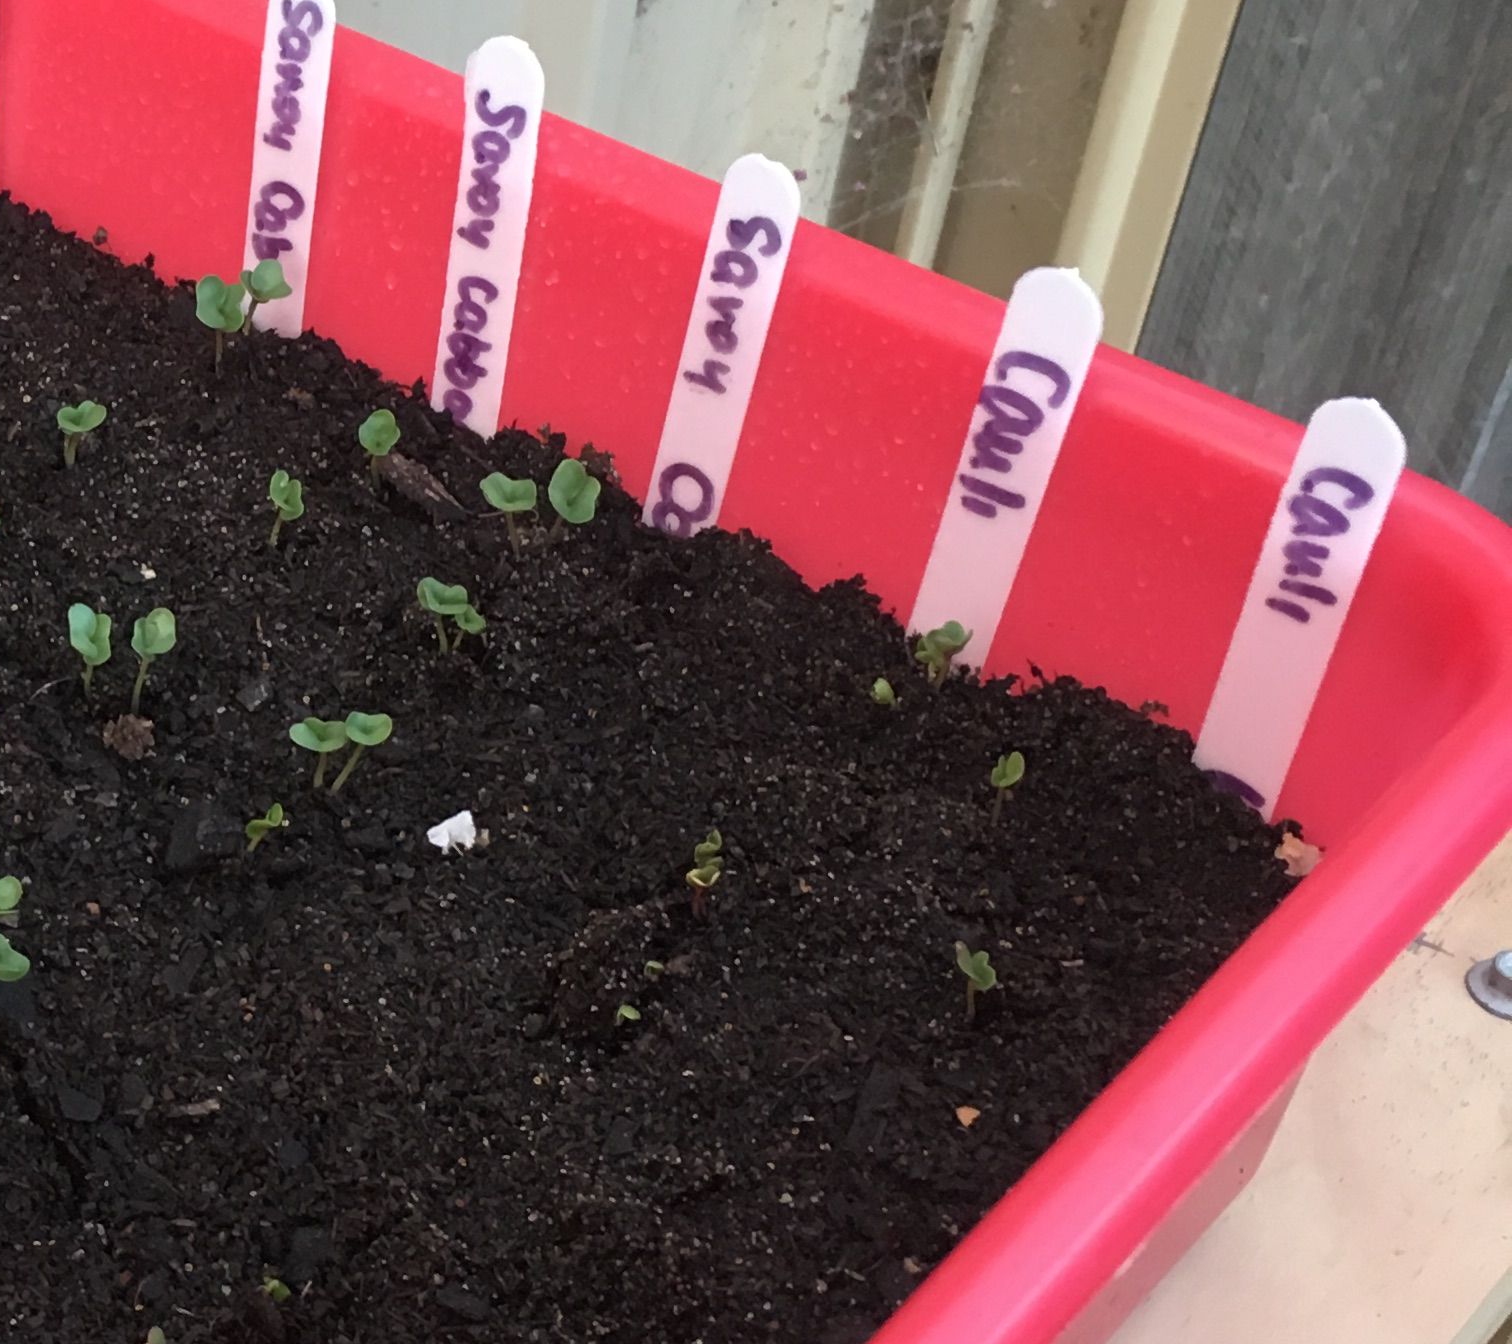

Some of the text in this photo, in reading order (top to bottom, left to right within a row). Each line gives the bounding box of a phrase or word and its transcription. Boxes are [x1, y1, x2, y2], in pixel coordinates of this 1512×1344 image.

[456, 88, 527, 250] Savoy
[682, 215, 782, 395] Savoy
[958, 349, 1071, 519] Cauli
[1264, 466, 1375, 623] Cauli
